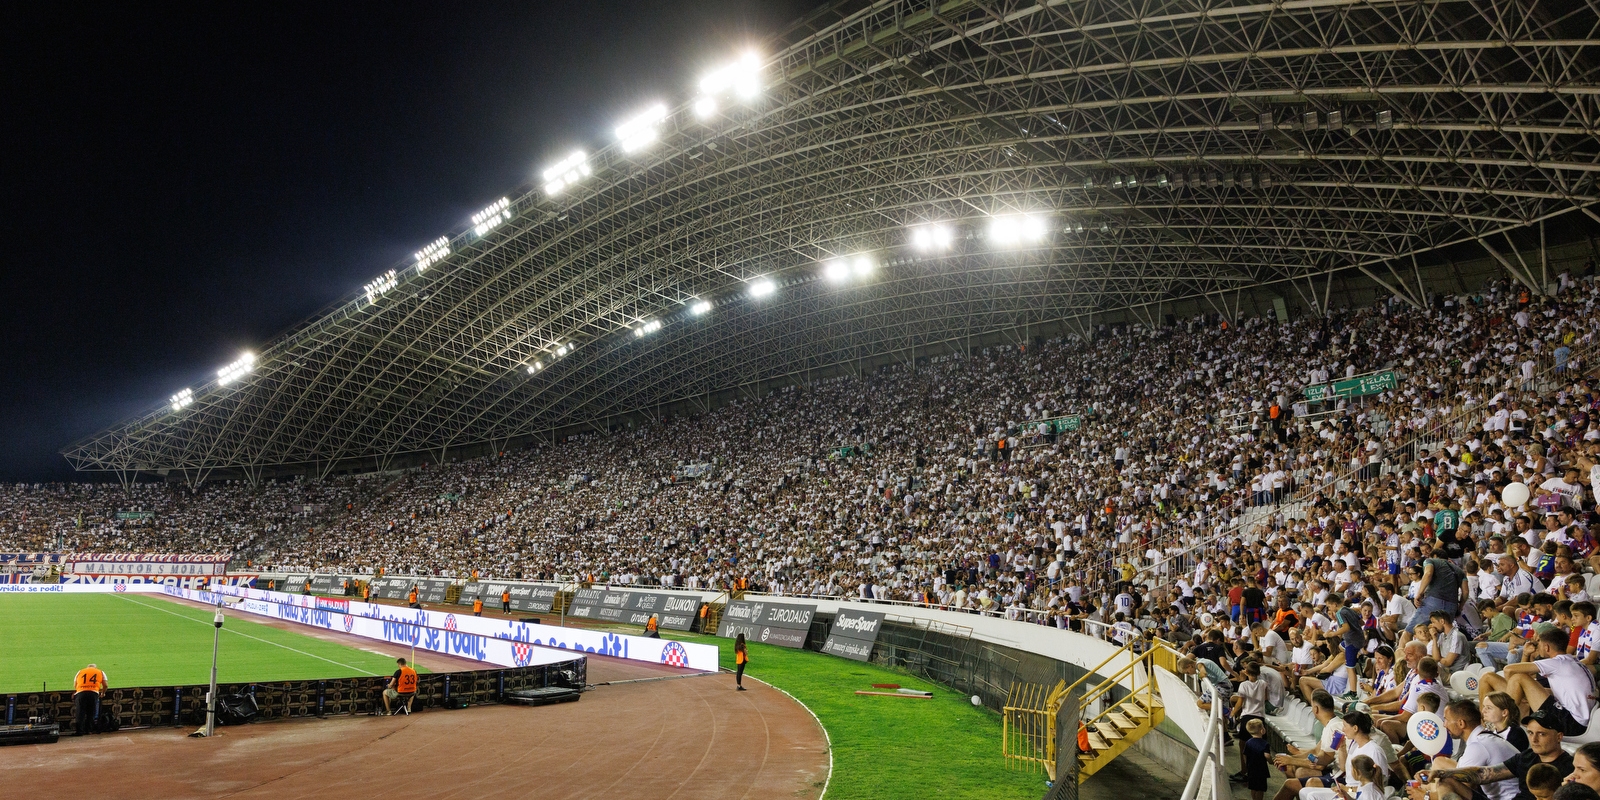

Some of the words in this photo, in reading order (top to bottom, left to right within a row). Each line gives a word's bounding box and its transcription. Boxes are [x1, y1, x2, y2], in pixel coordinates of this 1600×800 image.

[1366, 374, 1391, 385] IZLAZ
[1444, 516, 1452, 530] 8
[1539, 560, 1549, 571] 7
[671, 597, 696, 612] LUKOIL
[1121, 597, 1130, 607] 10
[768, 607, 810, 624] EURODAUS
[836, 613, 878, 633] SuperSport
[663, 642, 687, 659] HAJDUK
[81, 673, 98, 685] 14
[404, 674, 416, 685] 33
